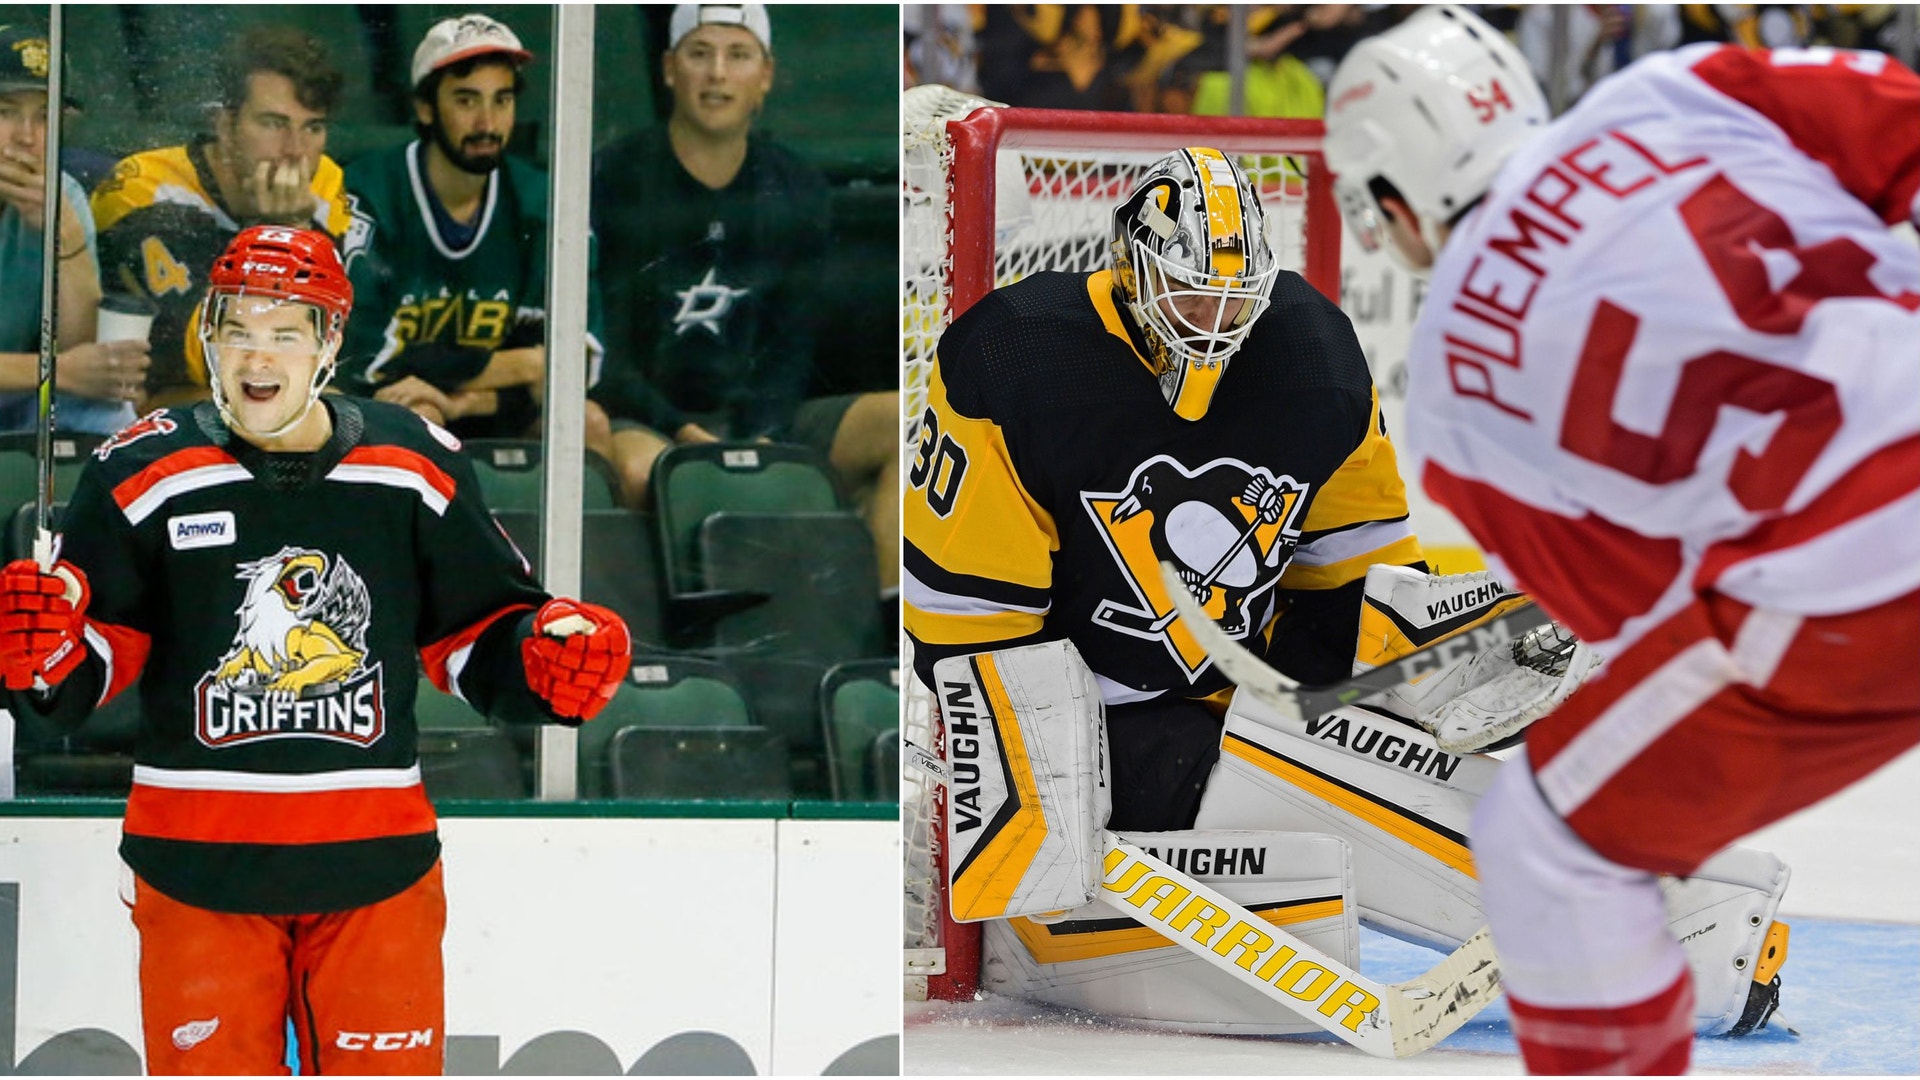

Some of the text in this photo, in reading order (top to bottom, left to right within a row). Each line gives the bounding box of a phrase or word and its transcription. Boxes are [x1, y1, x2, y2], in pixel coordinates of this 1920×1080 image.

[1466, 77, 1514, 124] 54
[141, 235, 192, 297] 4
[1442, 130, 1712, 424] PUEMPEL
[1558, 172, 1920, 514] 54
[909, 404, 970, 520] 30
[176, 521, 226, 537] Amway
[1426, 581, 1505, 621] VAUGHN
[1400, 618, 1512, 683] CCM
[205, 680, 375, 740] GRIFFINS
[943, 681, 982, 834] VAUGHN
[1305, 714, 1463, 782] VAUGHN
[1140, 847, 1267, 876] UGHN
[335, 1027, 434, 1052] CCM
